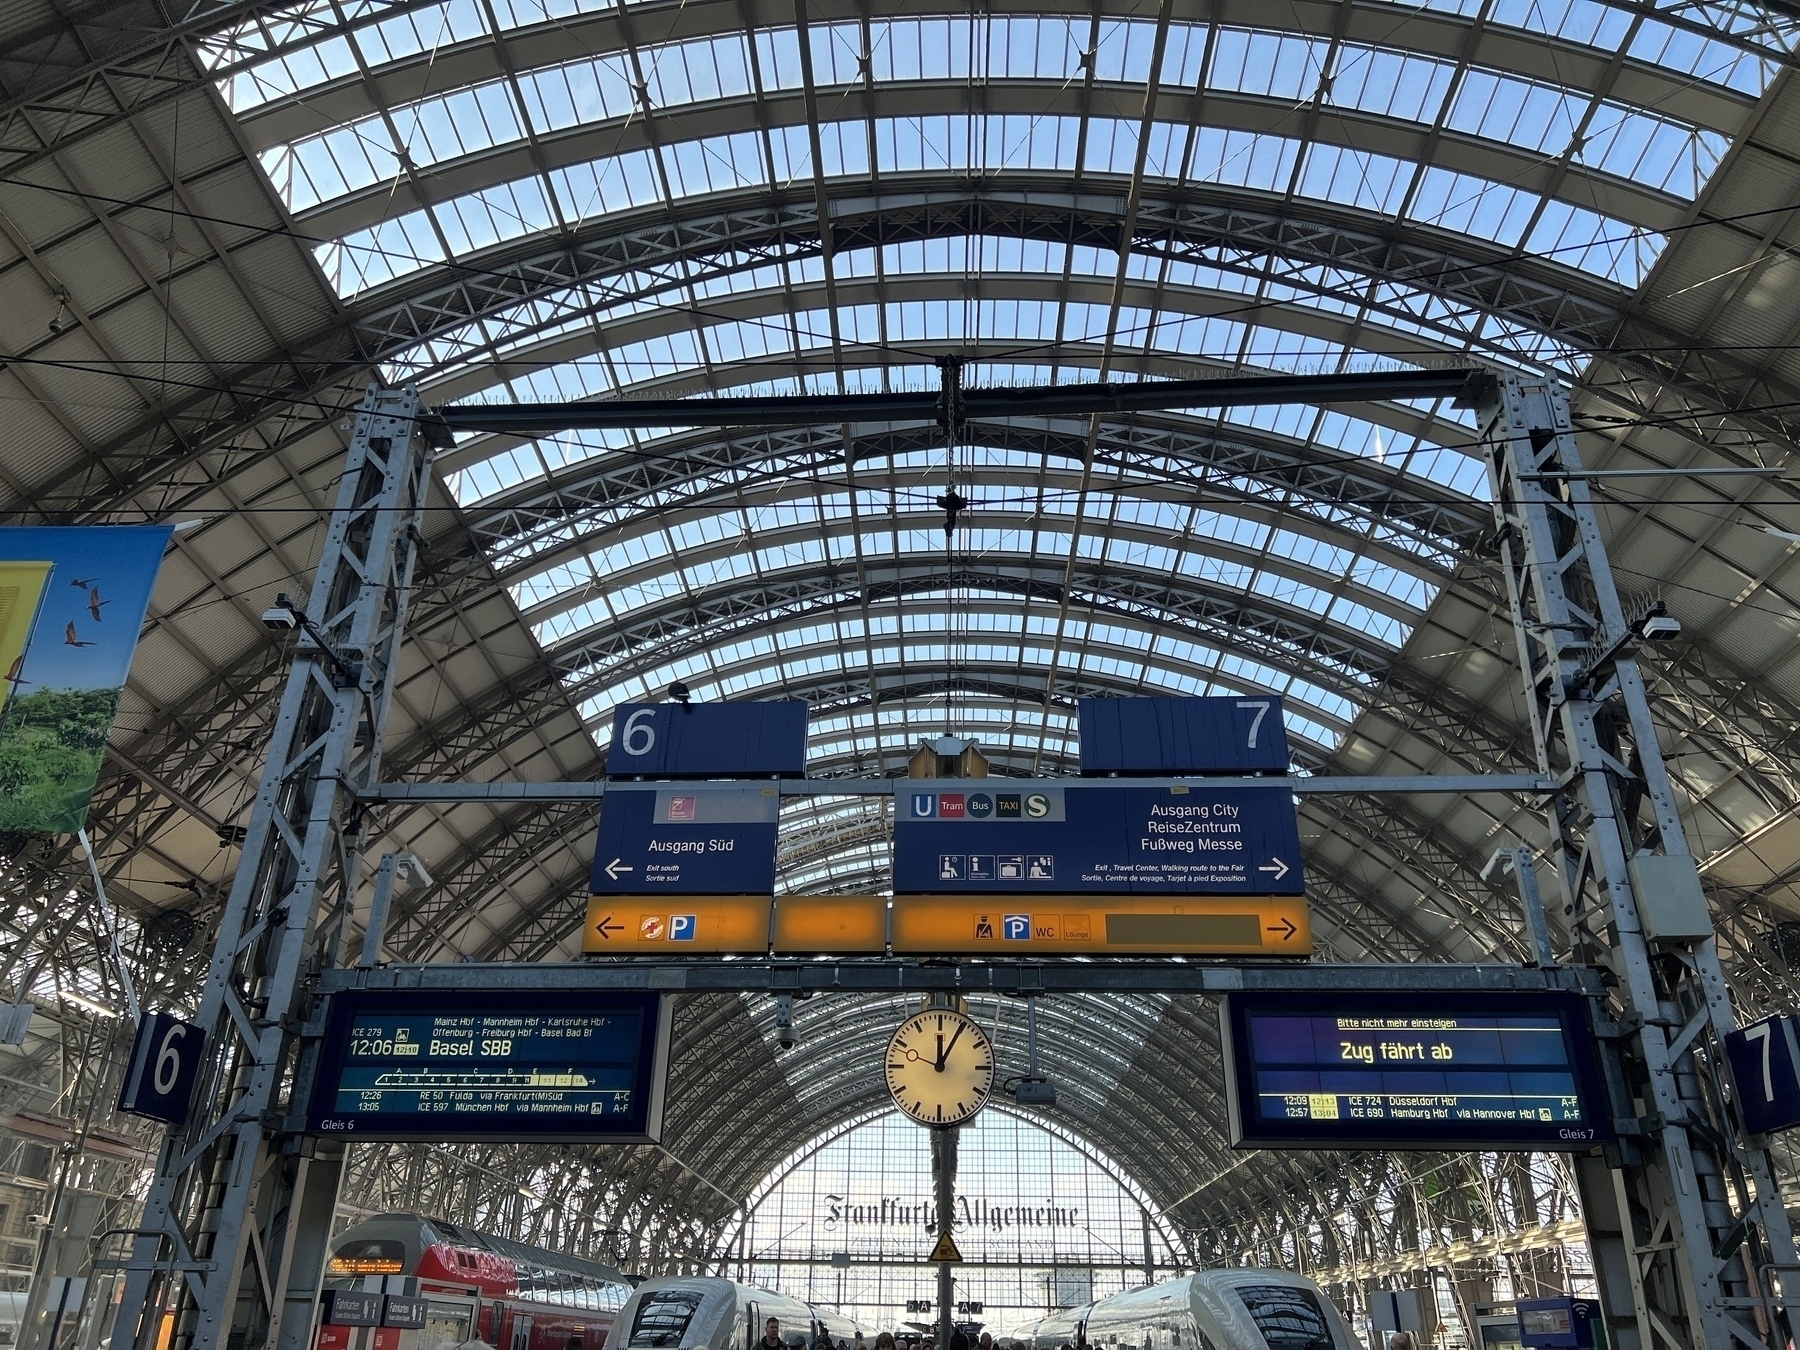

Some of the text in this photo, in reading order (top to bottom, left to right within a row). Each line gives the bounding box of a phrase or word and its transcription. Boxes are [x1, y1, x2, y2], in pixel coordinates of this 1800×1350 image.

[1236, 701, 1270, 749] 7
[622, 708, 656, 756] 6
[915, 795, 1047, 817] U Tram Bus TAXI S
[1151, 804, 1239, 818] Ausgang City
[1148, 821, 1241, 833] ReiseZentrum
[648, 839, 734, 854] Ausgang Süd
[1141, 838, 1243, 853] Fußweg Messe
[1167, 875, 1186, 883] Tarjet
[1210, 875, 1246, 883] Exposition
[670, 916, 688, 939] P
[1012, 922, 1024, 938] P
[1036, 927, 1054, 938] WC
[434, 1018, 458, 1026] Mainz
[459, 1018, 474, 1026] Hbf
[482, 1018, 523, 1026] Mannheim
[524, 1018, 540, 1026] Hbf
[548, 1018, 588, 1026] Karlsruhe
[590, 1018, 605, 1026] Hbf
[1337, 1019, 1457, 1029] Bitte nicht mehr einsteigen
[352, 1028, 382, 1037] ICE 279
[432, 1028, 473, 1038] Offenburg
[482, 1029, 515, 1038] Freiburg
[518, 1029, 533, 1037] Hbf
[541, 1029, 563, 1037] Basel
[566, 1029, 581, 1037] Bad
[583, 1029, 593, 1037] Bf
[350, 1039, 393, 1056] 12:06
[429, 1040, 474, 1056] Basel
[480, 1040, 512, 1056] SBB
[1340, 1042, 1453, 1064] Zug fährt ab
[154, 1023, 187, 1096] 6
[1744, 1022, 1774, 1102] 7
[360, 1091, 382, 1100] 12:26
[420, 1092, 430, 1100] RE
[433, 1092, 443, 1100] 50
[449, 1092, 473, 1100] Fulda
[480, 1092, 492, 1100] via
[1284, 1096, 1308, 1105] 12:09
[1348, 1097, 1363, 1105] ICE
[1366, 1097, 1382, 1105] 724
[1389, 1097, 1438, 1106] Düsseldorf
[1442, 1097, 1458, 1106] Hbf
[1561, 1098, 1577, 1107] A-F
[358, 1102, 628, 1113] 13:05 ICE 597 München Hbf via Mannheim Hbf A-F
[1285, 1108, 1308, 1117] 12:57
[1350, 1108, 1364, 1118] ICE
[1366, 1108, 1383, 1118] 690
[1391, 1108, 1430, 1120] Hamburg
[1432, 1108, 1448, 1118] Hbf
[1456, 1109, 1471, 1118] via
[1473, 1109, 1515, 1119] Hannover
[1519, 1109, 1536, 1119] Hbf
[1564, 1110, 1580, 1119] A-F
[321, 1120, 355, 1130] Gleis 6
[1559, 1128, 1594, 1140] Gleis 7
[824, 1194, 1078, 1233] Frankfurt Allgemeine
[907, 1302, 928, 1311] 6 A
[961, 1303, 980, 1312] A 7
